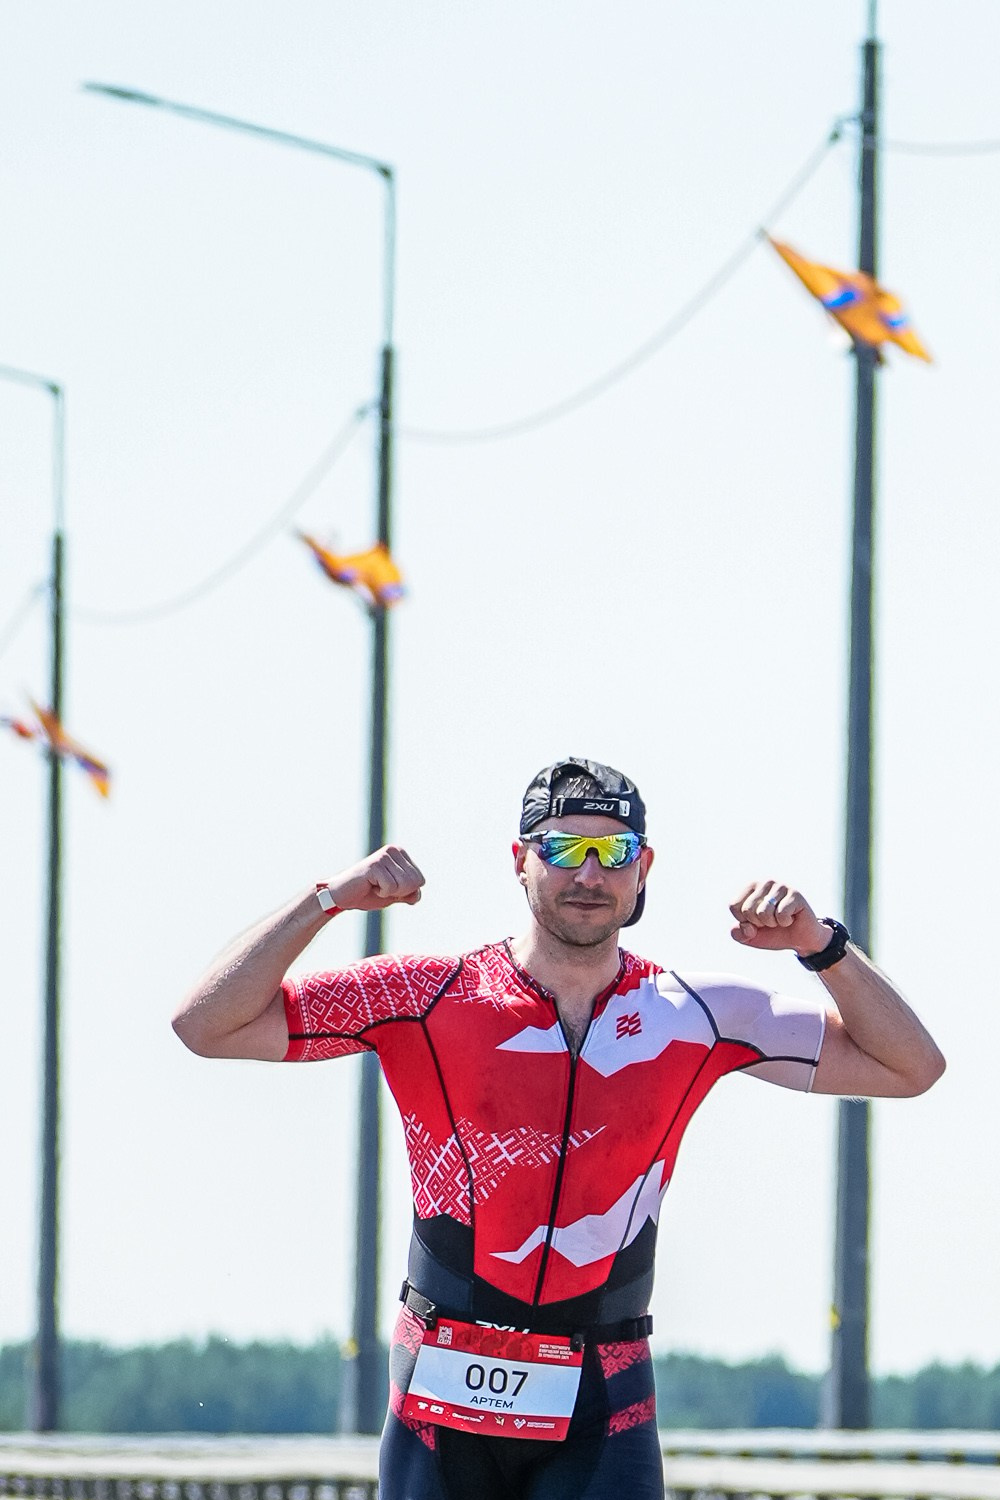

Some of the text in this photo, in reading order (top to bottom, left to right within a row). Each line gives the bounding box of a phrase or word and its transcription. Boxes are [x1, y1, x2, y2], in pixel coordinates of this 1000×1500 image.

[583, 802, 614, 811] 2XU
[465, 1363, 529, 1397] 007
[470, 1395, 514, 1409] АРТЕМ
